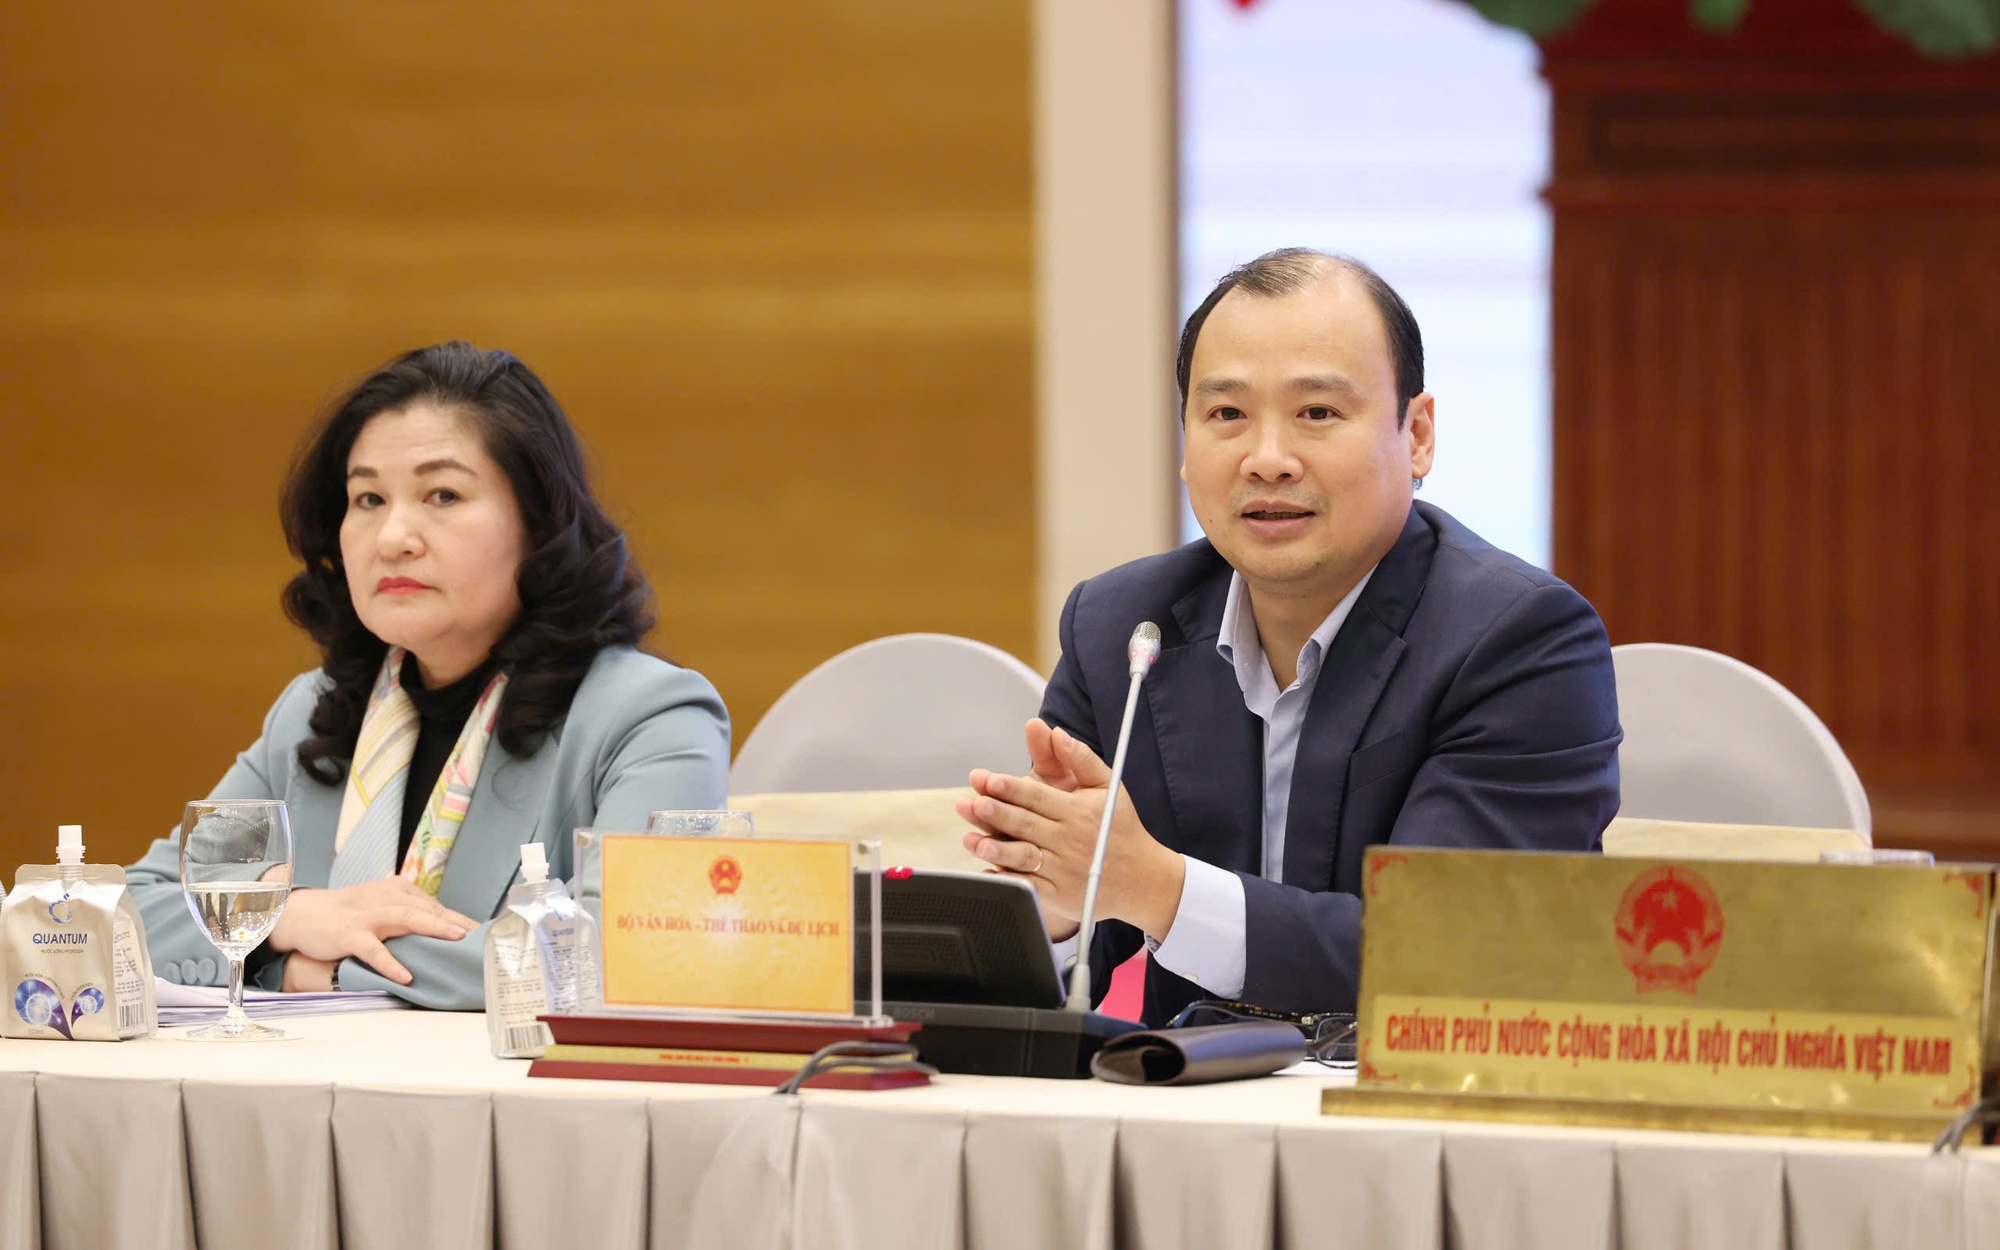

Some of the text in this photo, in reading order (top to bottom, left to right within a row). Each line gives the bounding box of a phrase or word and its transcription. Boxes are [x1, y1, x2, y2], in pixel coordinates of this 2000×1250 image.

[637, 914, 662, 931] VĂN
[732, 919, 767, 934] THAO
[808, 920, 839, 938] LỊCH
[32, 933, 87, 944] QUANTUM
[893, 1007, 936, 1019] BOSCH
[1386, 1001, 1952, 1082] CHÍNH PHỦ NƯỚC CỘNG HÒA XÃ HỘI CHỦ NGHĨA VIỆT NAM
